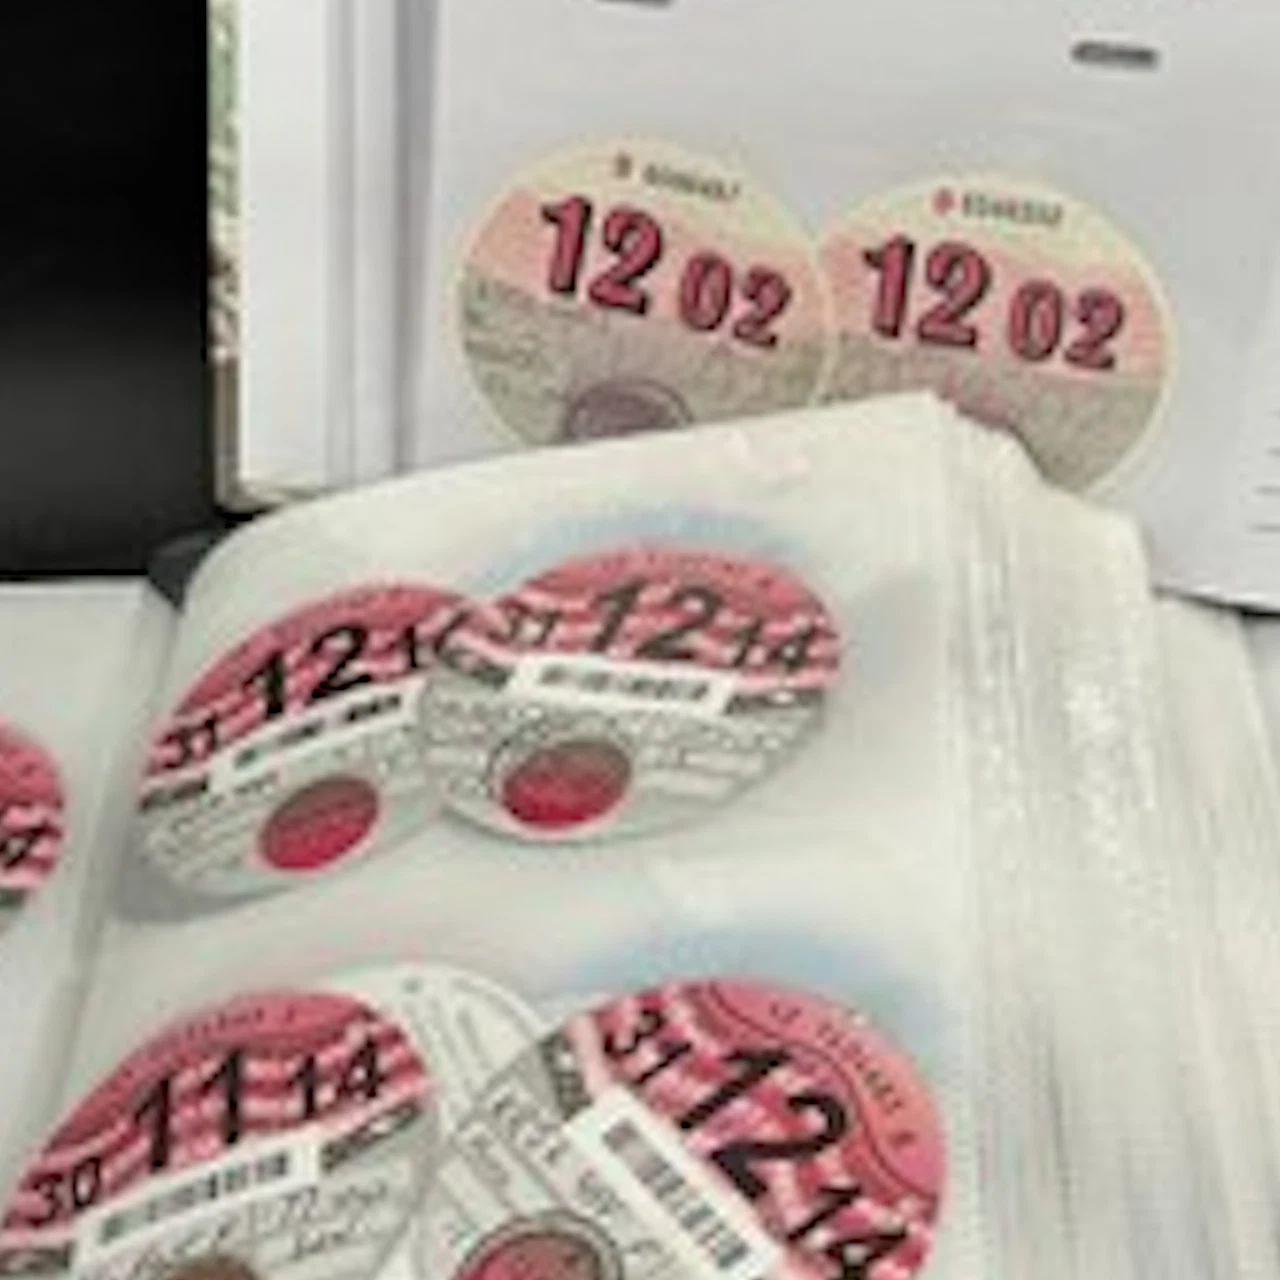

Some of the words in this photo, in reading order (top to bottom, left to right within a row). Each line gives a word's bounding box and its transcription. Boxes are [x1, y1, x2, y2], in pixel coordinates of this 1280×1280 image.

[540, 195, 665, 318] 12
[678, 251, 794, 350] 02
[862, 232, 993, 353] 12
[1006, 279, 1127, 372] 02
[246, 623, 374, 716] 12
[588, 576, 726, 663] 12
[732, 617, 818, 672] 14
[26, 1157, 102, 1229] 30
[131, 1049, 242, 1170] 11
[289, 1035, 385, 1117] 14
[600, 1010, 693, 1086] 31
[679, 1046, 850, 1202] 12
